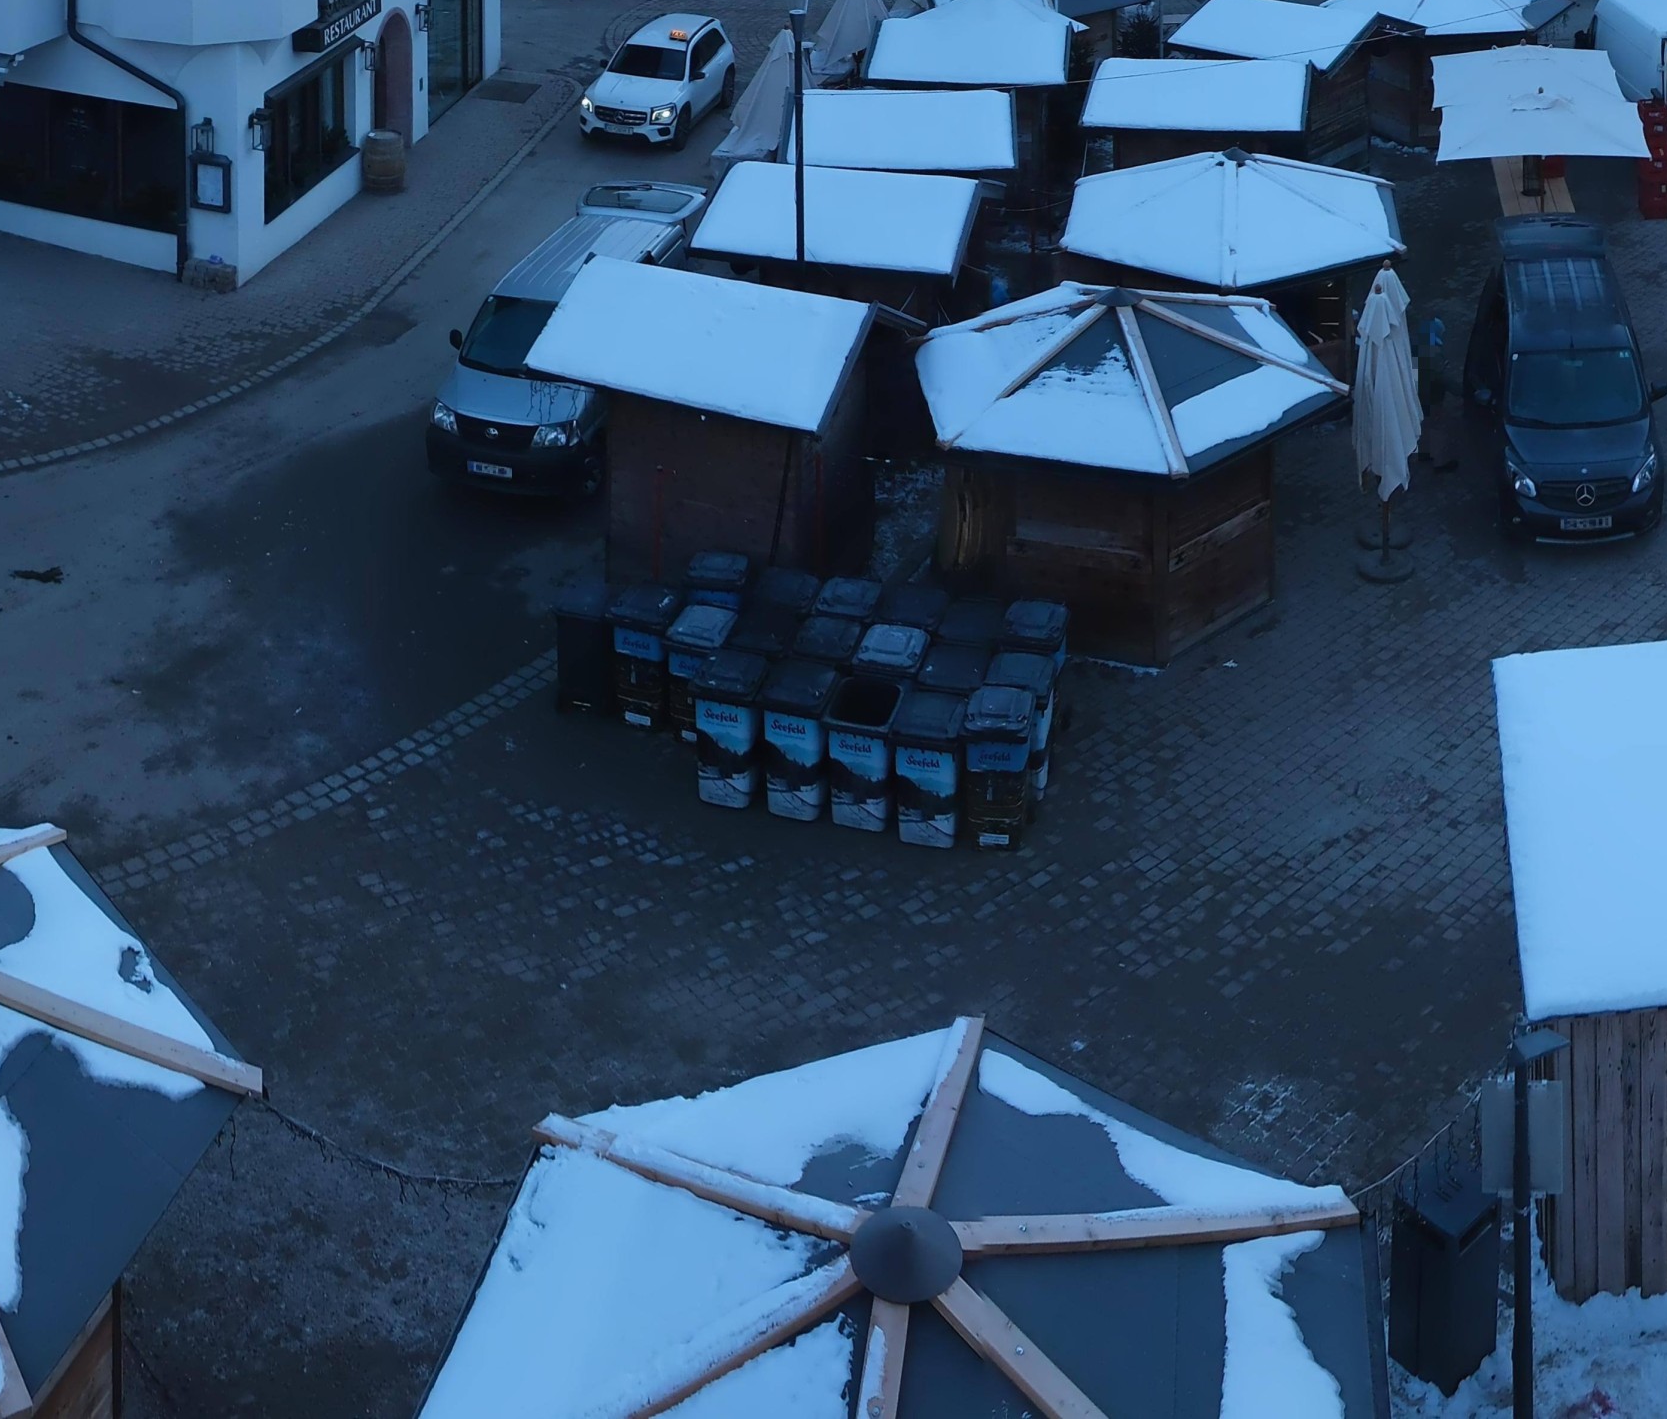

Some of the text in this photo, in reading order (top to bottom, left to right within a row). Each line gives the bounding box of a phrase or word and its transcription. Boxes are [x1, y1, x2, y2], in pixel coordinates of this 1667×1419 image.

[623, 637, 650, 651] Seefeld
[703, 707, 739, 724] Seefeld
[770, 719, 806, 736] Seefeld
[838, 739, 872, 754] Seefeld
[904, 754, 941, 769] Seefeld
